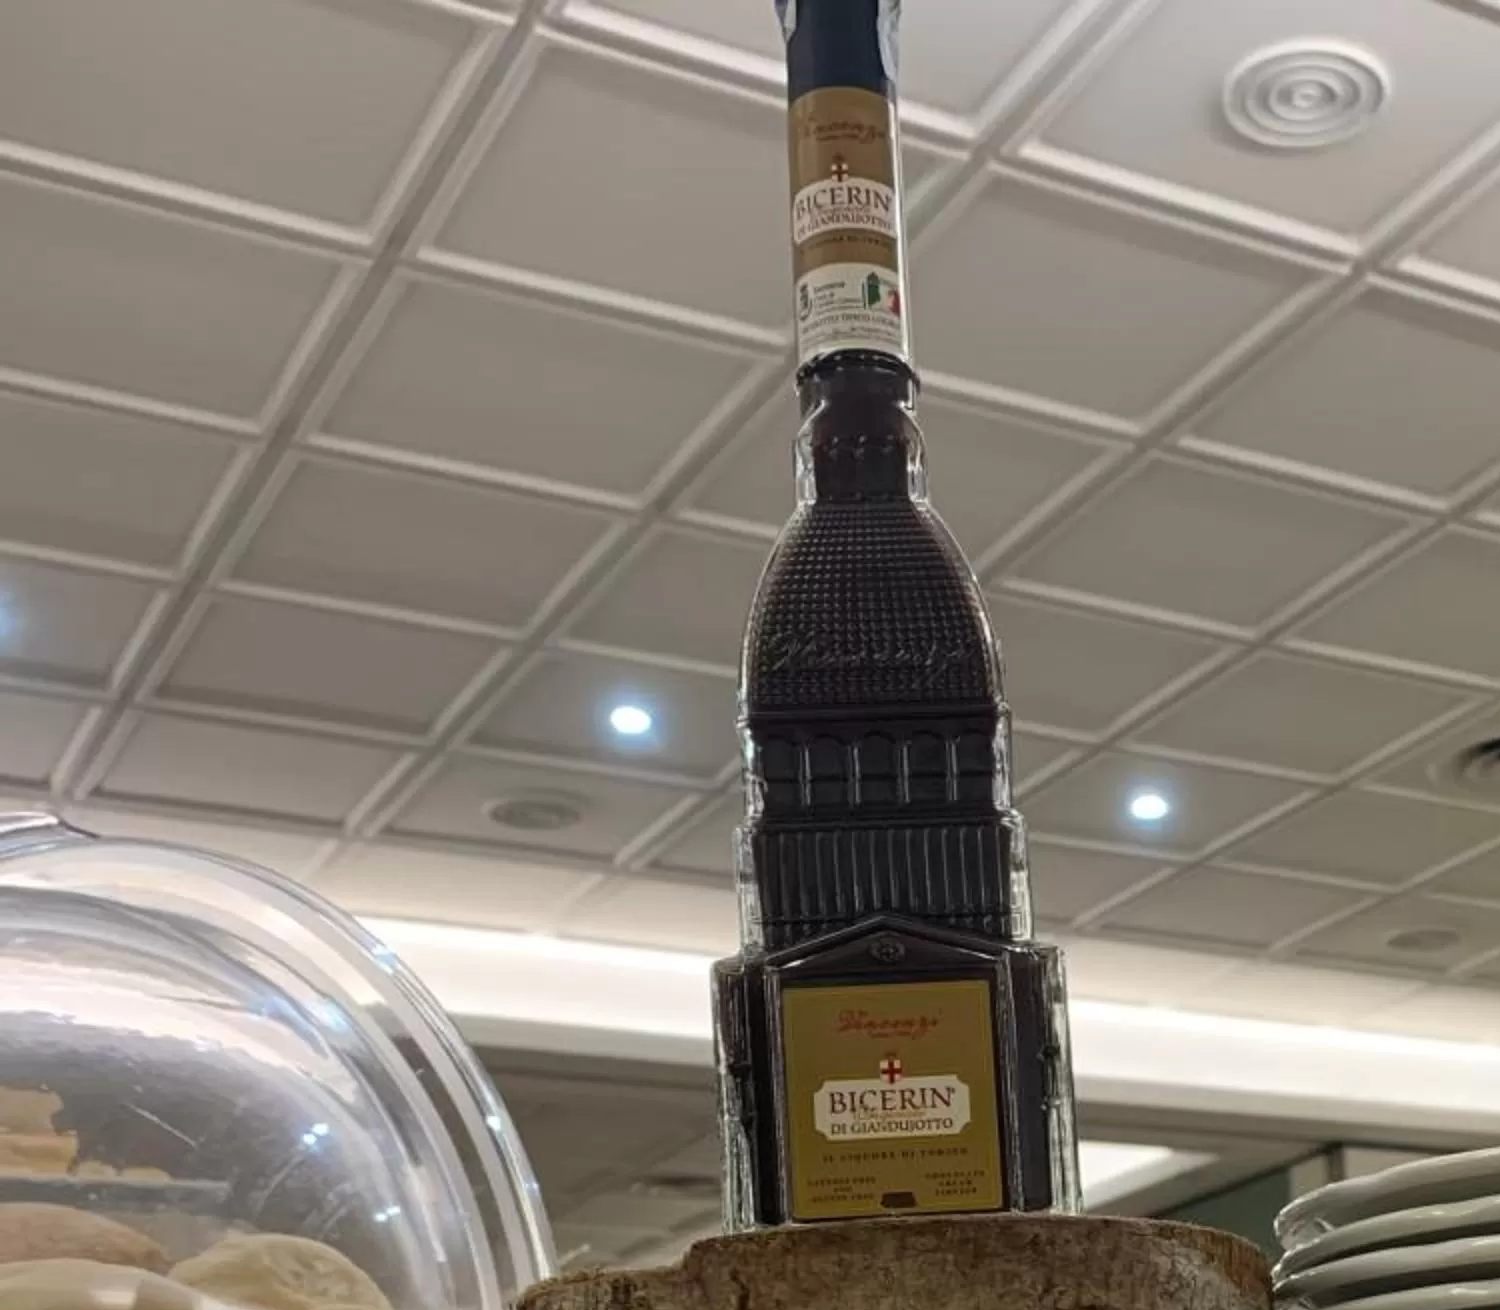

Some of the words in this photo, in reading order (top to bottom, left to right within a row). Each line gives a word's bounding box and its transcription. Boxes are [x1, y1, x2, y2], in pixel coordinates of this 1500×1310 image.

[795, 186, 891, 221] BICERIN
[829, 1086, 953, 1114] BICERIN
[831, 1123, 847, 1135] DI
